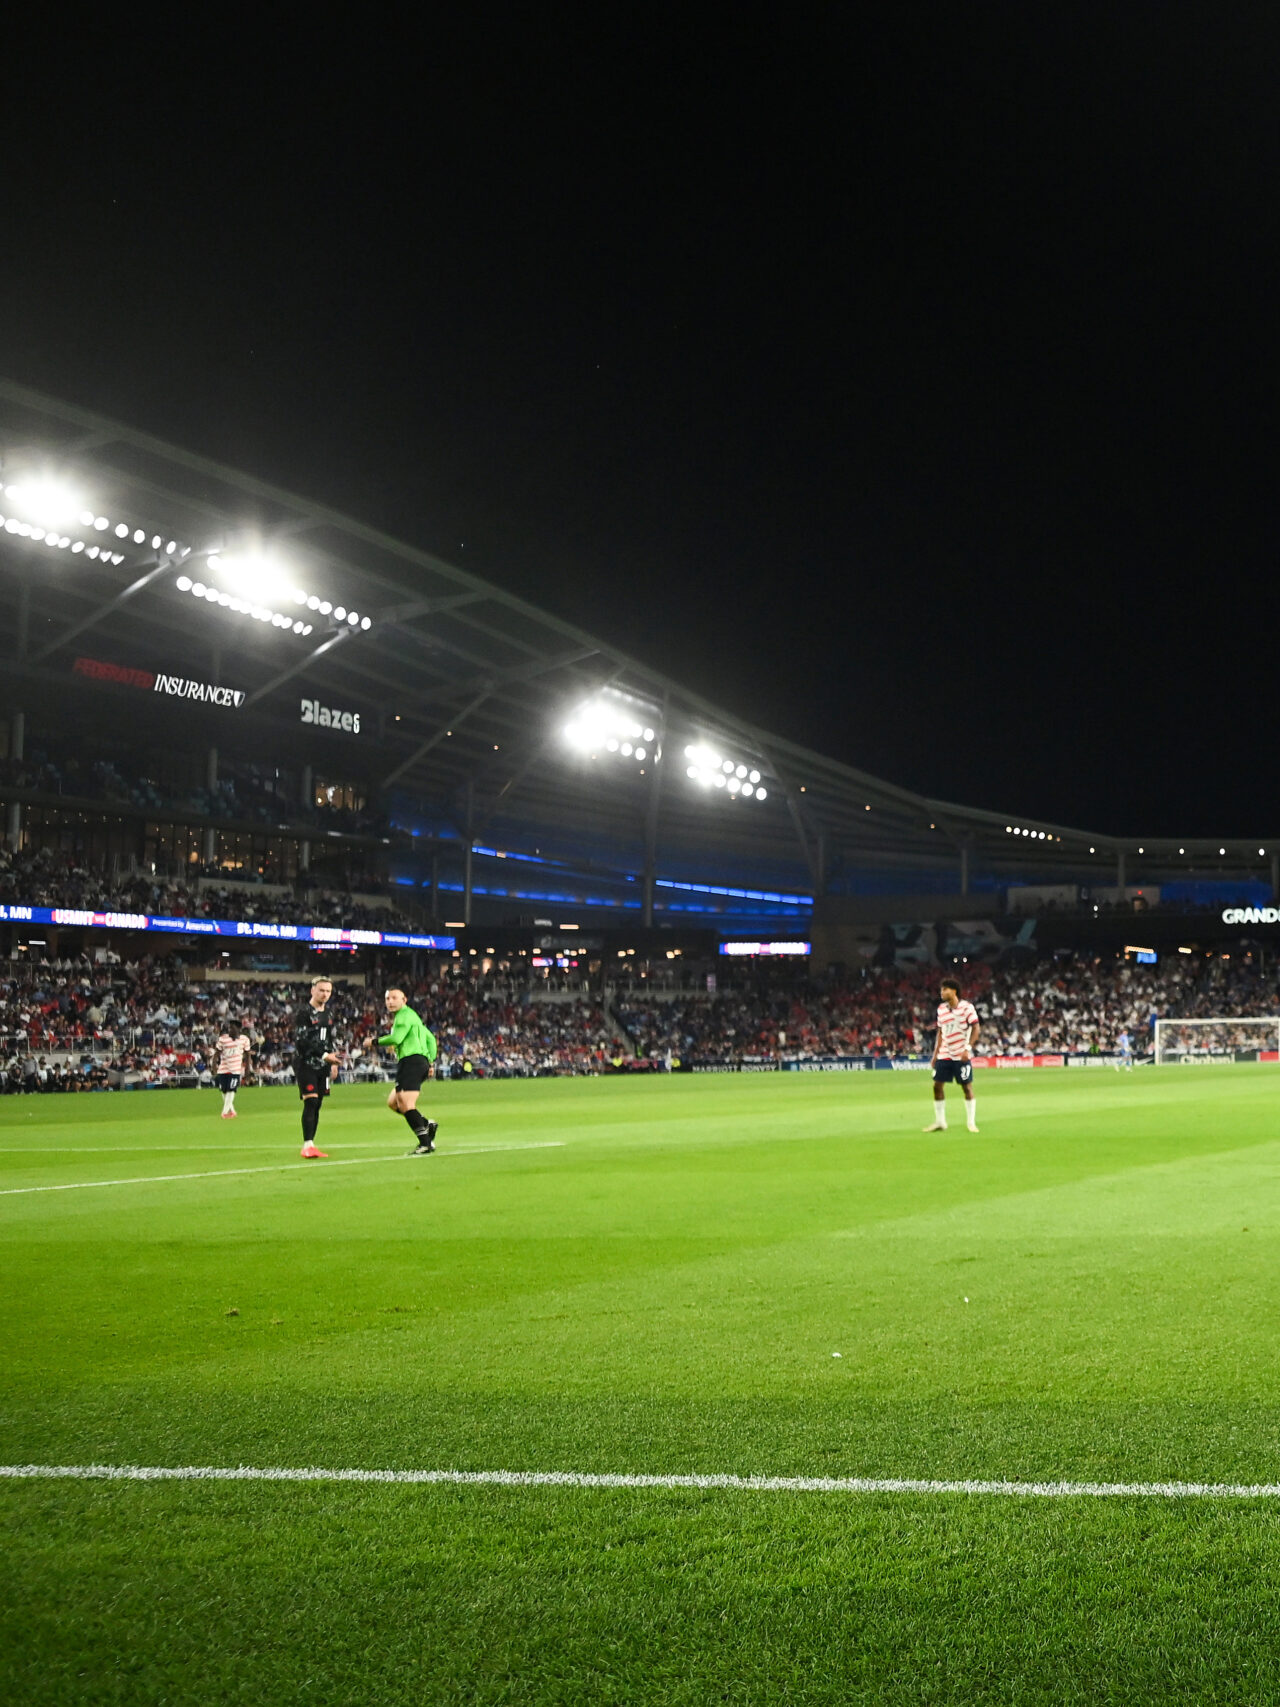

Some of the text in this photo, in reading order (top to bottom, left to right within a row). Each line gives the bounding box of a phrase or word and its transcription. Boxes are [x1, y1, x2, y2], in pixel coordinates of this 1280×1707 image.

[154, 673, 233, 707] INSURANCE
[10, 906, 32, 919] MN
[55, 909, 94, 925] USMNT
[105, 912, 146, 928] CANADA
[1222, 908, 1278, 924] GRAND
